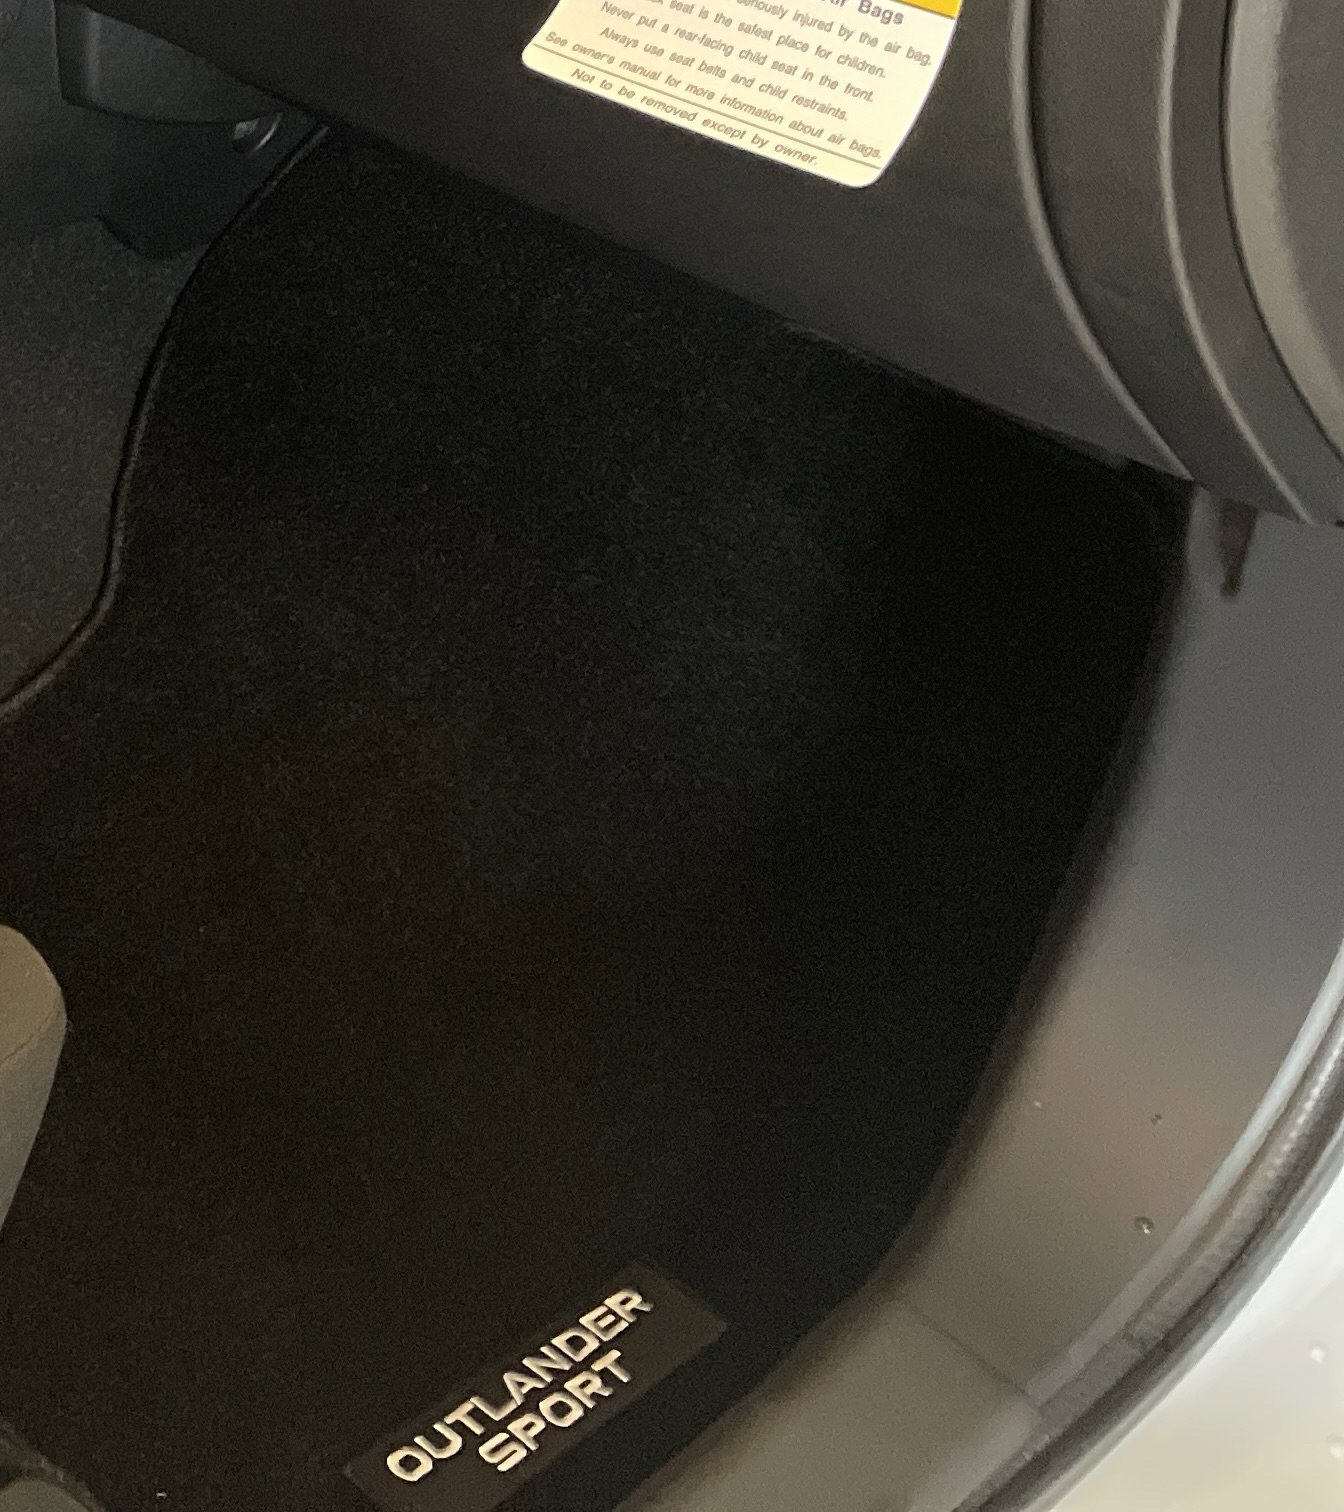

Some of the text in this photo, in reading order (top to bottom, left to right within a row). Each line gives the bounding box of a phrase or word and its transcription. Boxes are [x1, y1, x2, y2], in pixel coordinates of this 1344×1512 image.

[600, 0, 636, 21] Never
[636, 15, 658, 29] put
[661, 23, 670, 34] a
[674, 27, 734, 57] rear-facing
[739, 48, 768, 66] child
[771, 60, 798, 76] seat
[801, 67, 814, 82] in
[818, 74, 839, 90] the
[600, 26, 640, 48] Always
[643, 42, 665, 57] use
[669, 51, 695, 68] seat
[698, 60, 727, 79] belts
[730, 73, 756, 89] and
[758, 83, 789, 100] child
[698, 6, 710, 20] is
[714, 12, 733, 28] the
[737, 20, 774, 40] safest
[776, 34, 810, 53] place
[814, 44, 833, 60] for
[792, 9, 835, 33] injured
[837, 24, 856, 42] by
[858, 31, 879, 48] the
[883, 40, 902, 54] air
[545, 31, 569, 47] See
[572, 42, 615, 65] owner's
[618, 59, 662, 81] manual
[664, 74, 682, 88] for
[684, 82, 716, 101] more
[719, 93, 784, 125] information
[788, 119, 824, 138] about
[827, 132, 846, 145] air
[571, 68, 596, 84] Not
[599, 79, 613, 91] to
[617, 85, 636, 99] be
[640, 94, 698, 122] removed
[701, 117, 747, 140] except
[750, 133, 770, 149] by
[386, 1287, 654, 1482] OUTLANDER
[477, 1348, 632, 1473] SPORT
